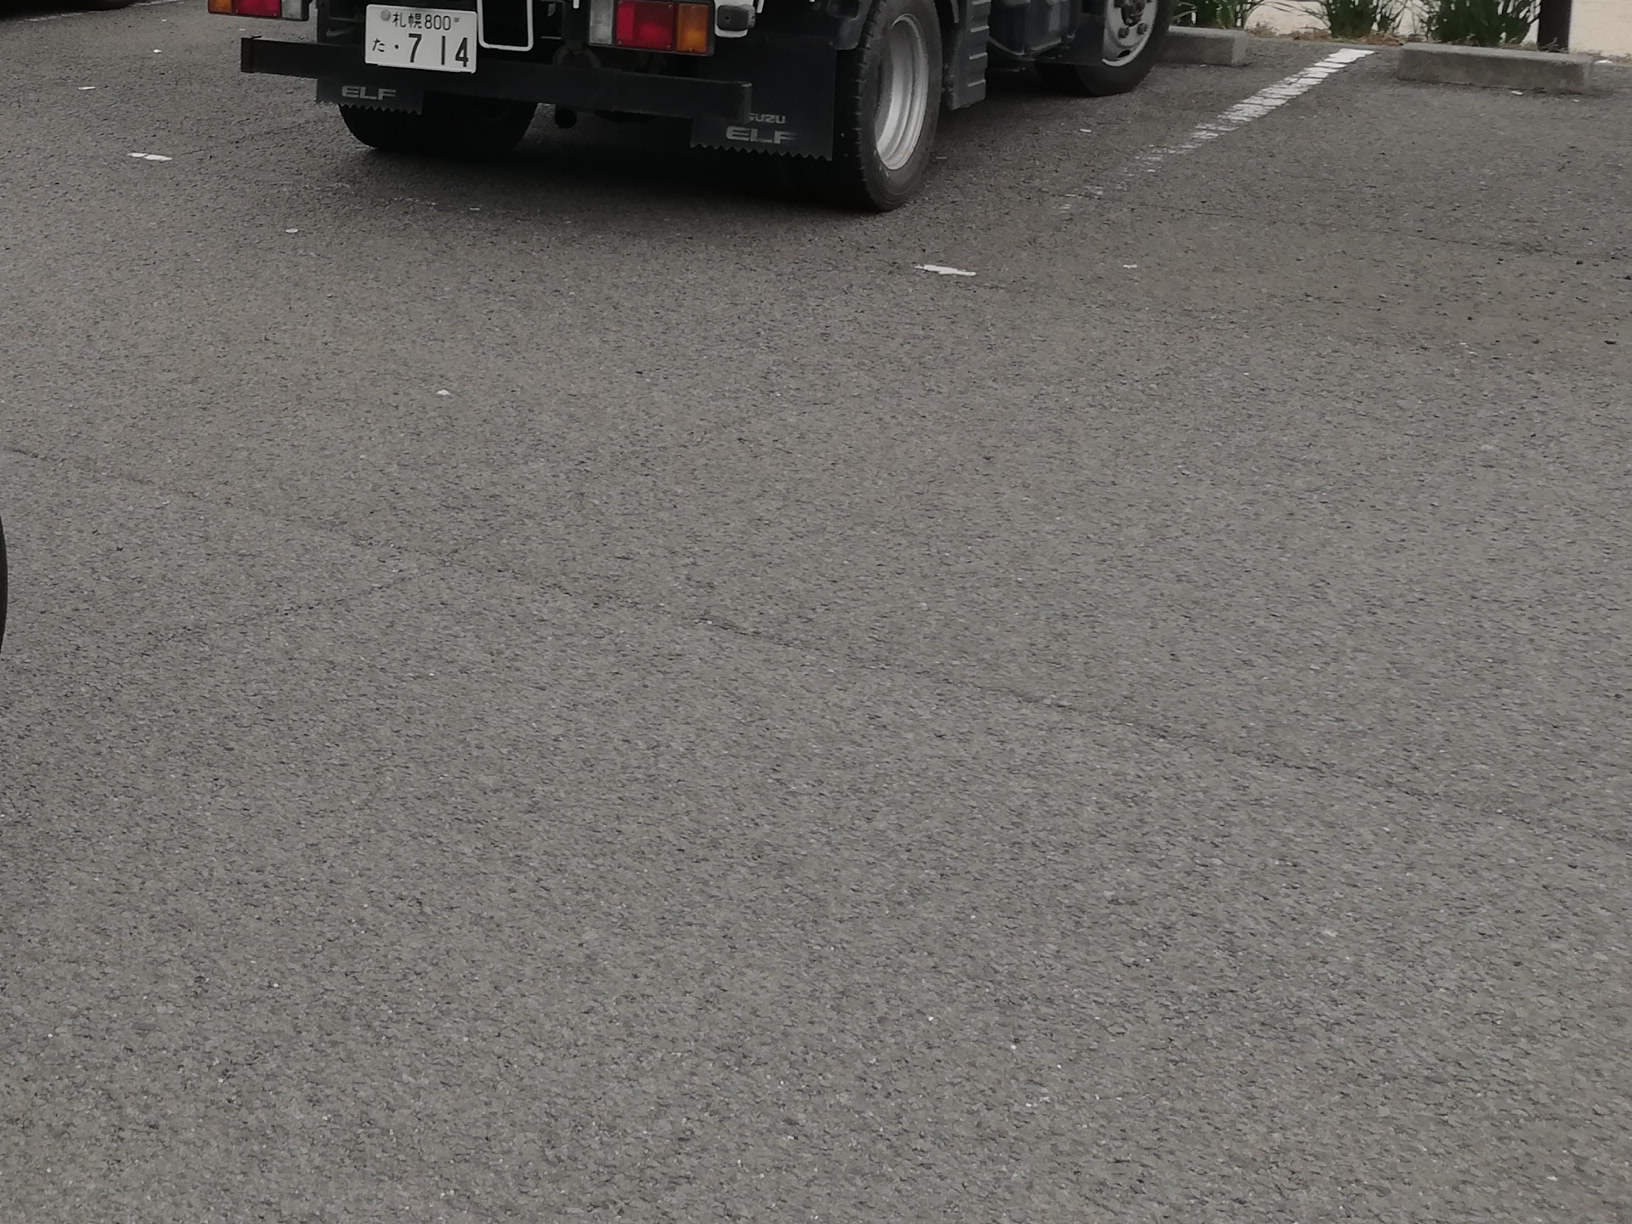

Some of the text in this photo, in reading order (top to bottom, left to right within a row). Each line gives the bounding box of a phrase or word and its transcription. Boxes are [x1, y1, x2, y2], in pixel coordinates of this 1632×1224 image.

[371, 37, 386, 53] た
[341, 85, 397, 101] ELF
[749, 112, 786, 124] SUZU
[725, 126, 797, 145] ELF
